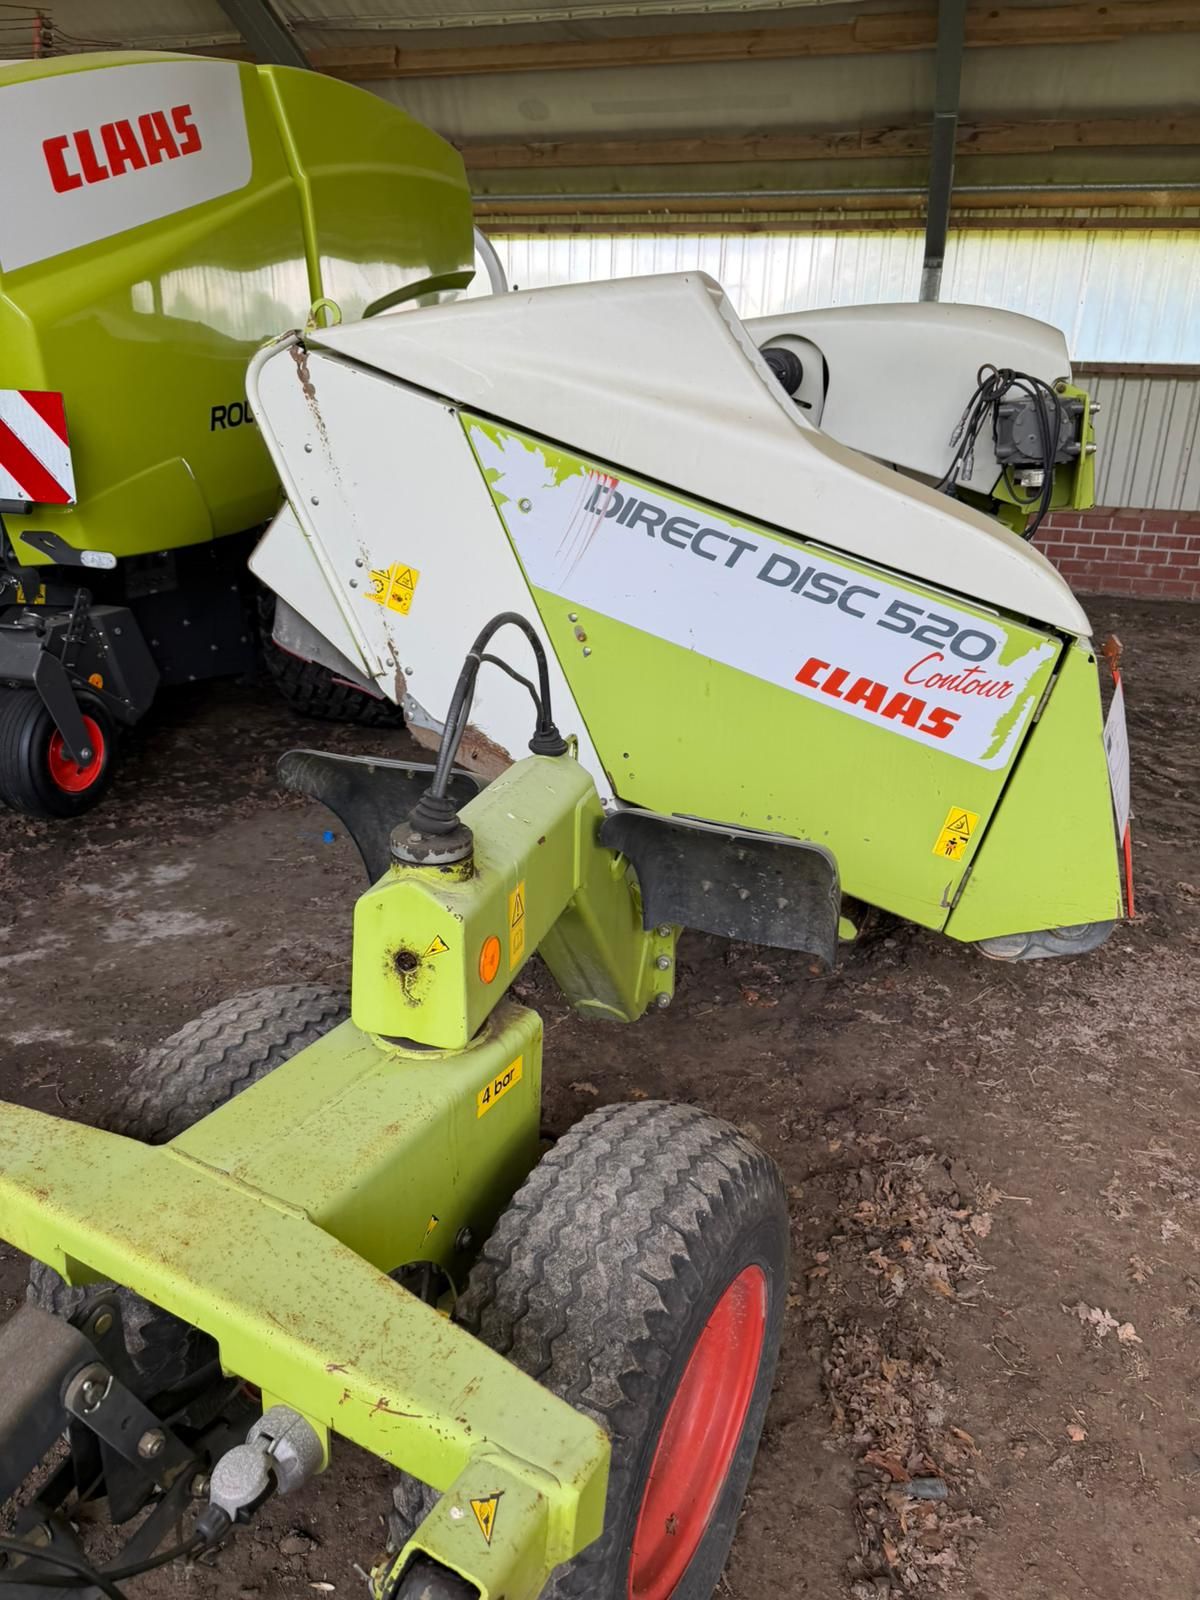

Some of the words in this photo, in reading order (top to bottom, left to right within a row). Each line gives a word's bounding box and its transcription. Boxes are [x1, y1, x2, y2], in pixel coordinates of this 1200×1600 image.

[42, 104, 202, 193] CLAAS
[583, 484, 759, 569] DIRECT
[756, 552, 880, 619] DISC
[876, 599, 997, 662] 520
[794, 656, 962, 738] CLAAS
[903, 651, 1014, 699] Contour
[482, 1086, 491, 1104] 4
[494, 1068, 515, 1096] bar
